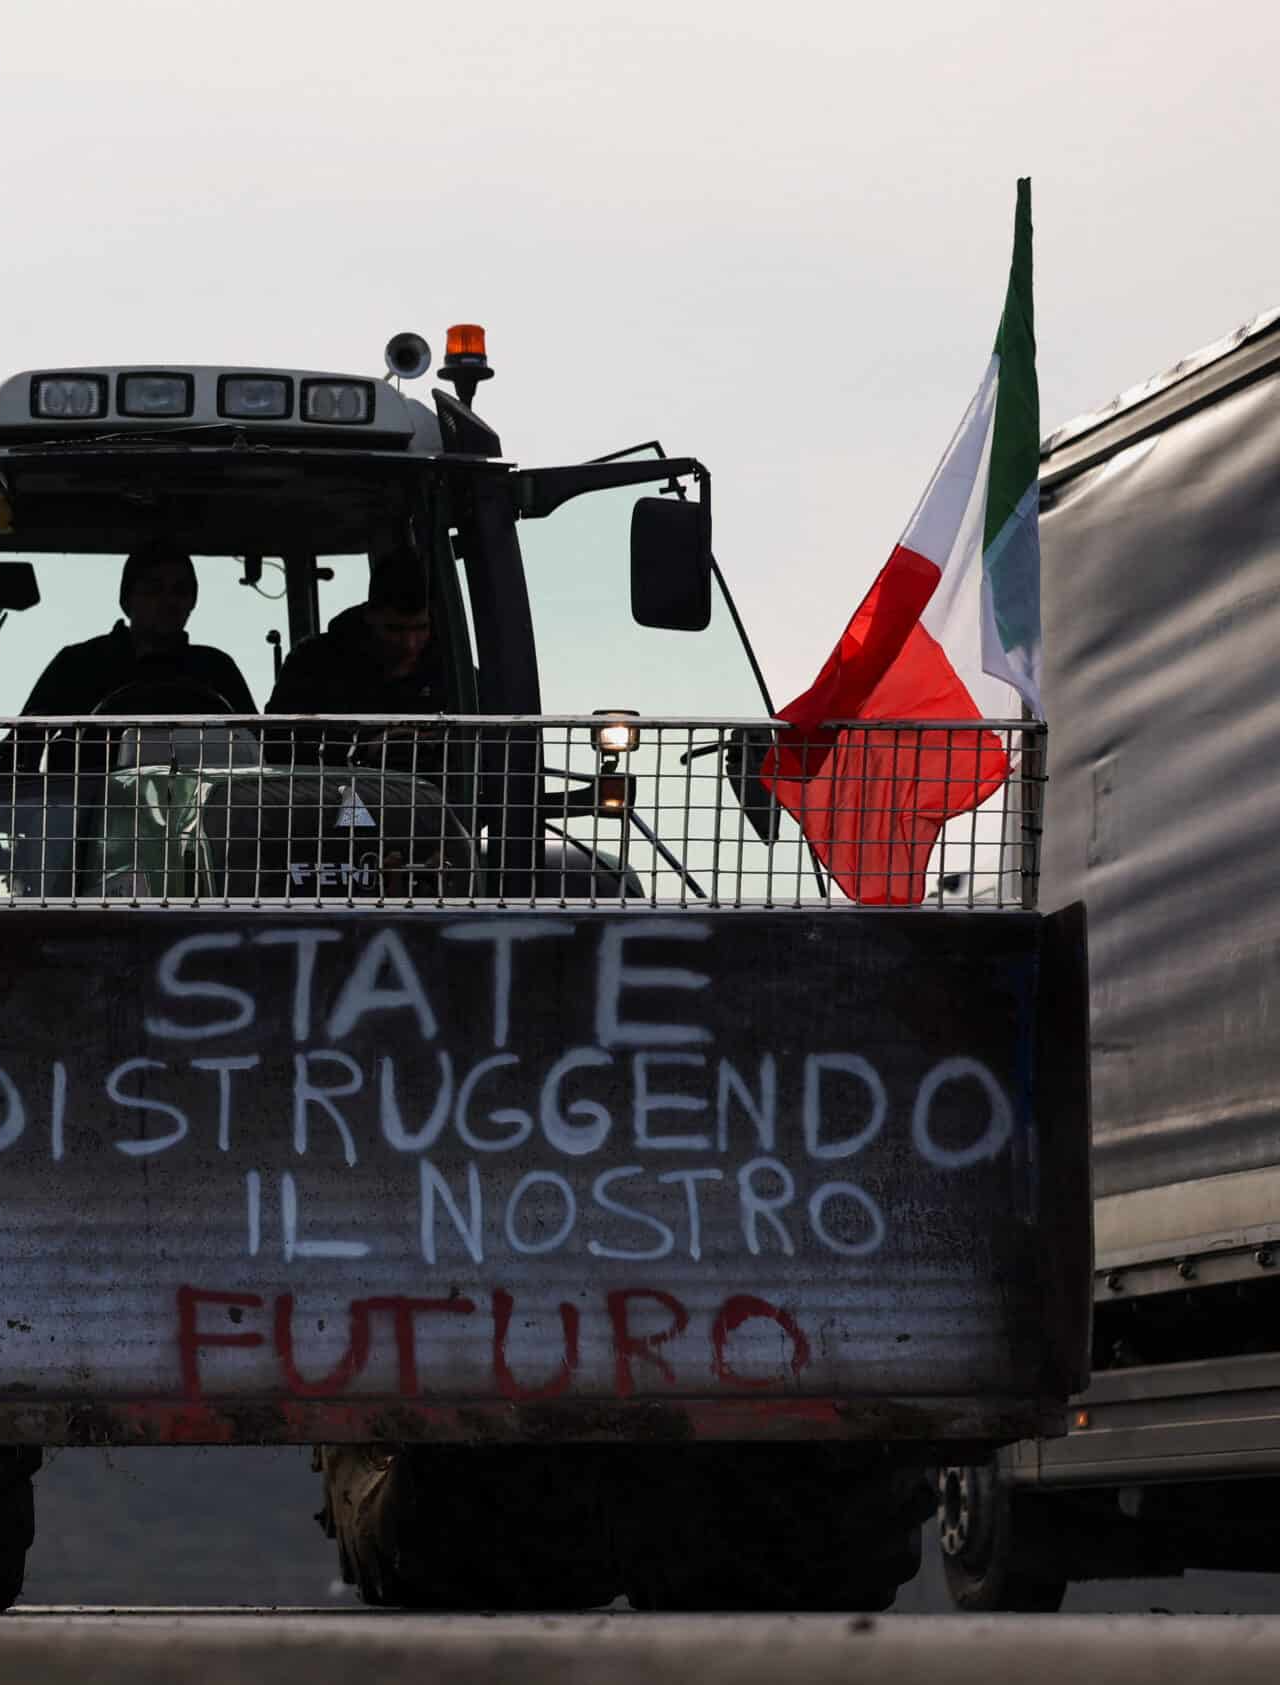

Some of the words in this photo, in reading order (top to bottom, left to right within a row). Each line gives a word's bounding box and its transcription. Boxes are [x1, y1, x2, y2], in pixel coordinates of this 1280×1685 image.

[144, 921, 712, 1048] STATE
[246, 1170, 370, 1263] IL
[420, 1158, 885, 1265] NOSTRO
[175, 1284, 810, 1398] FUTURO
